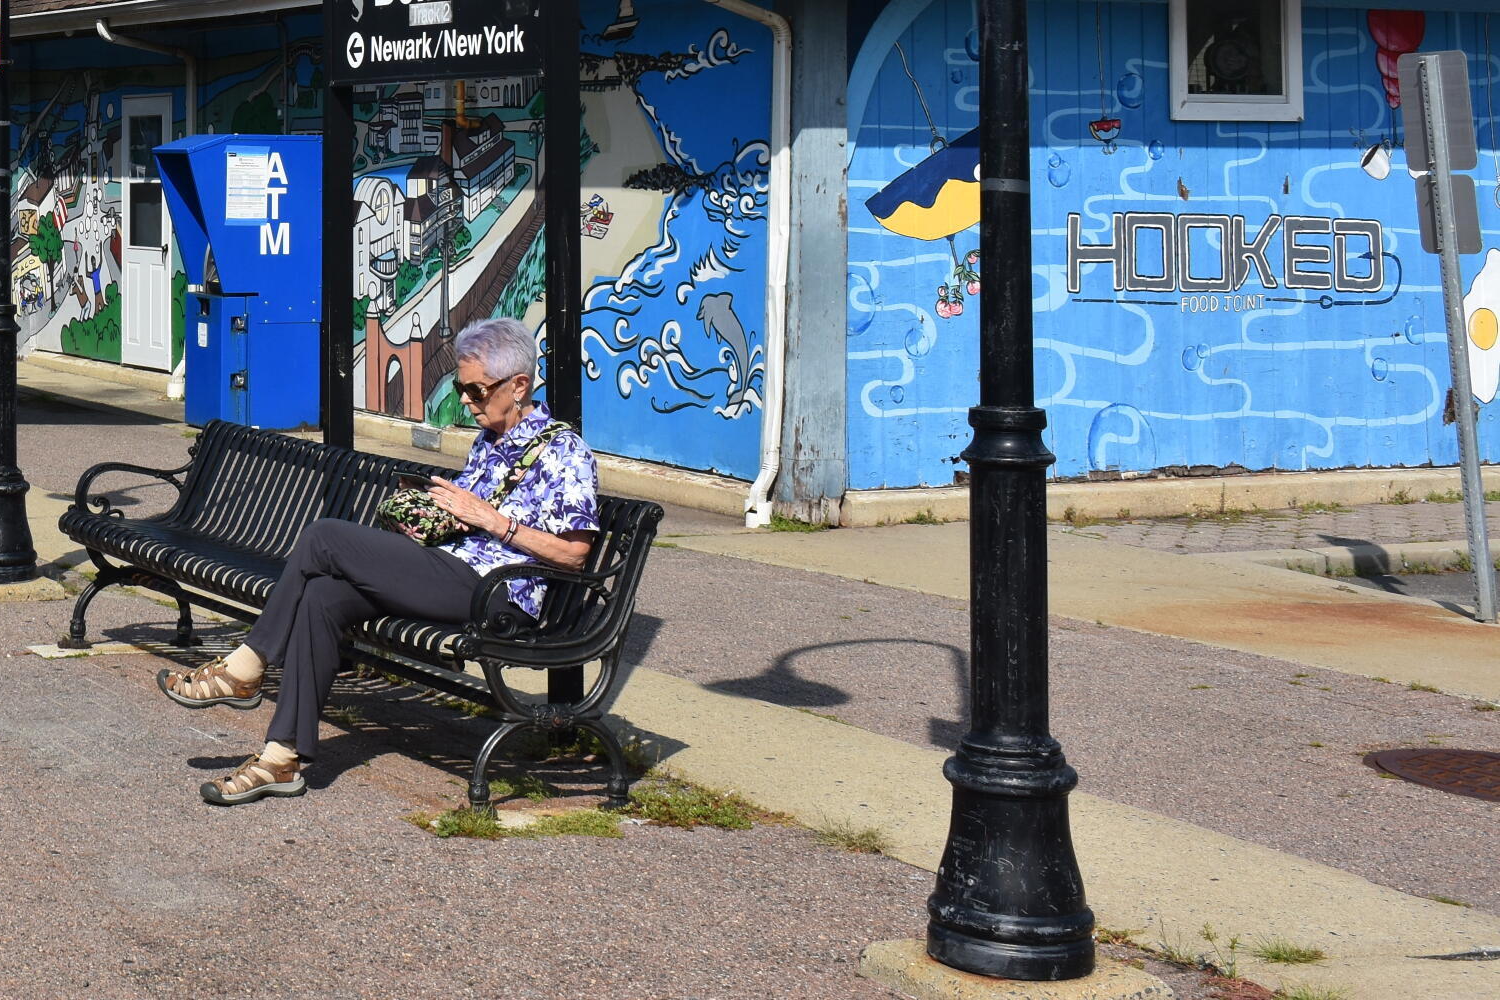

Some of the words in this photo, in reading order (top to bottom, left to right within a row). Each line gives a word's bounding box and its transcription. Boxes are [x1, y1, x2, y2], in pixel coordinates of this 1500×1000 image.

[411, 3, 440, 25] Track
[442, 2, 450, 22] 2
[484, 24, 525, 55] York
[259, 152, 290, 255] ATM
[1066, 211, 1385, 293] HOOKED
[1181, 296, 1219, 313] FOOD
[1222, 295, 1266, 312] JOINT
